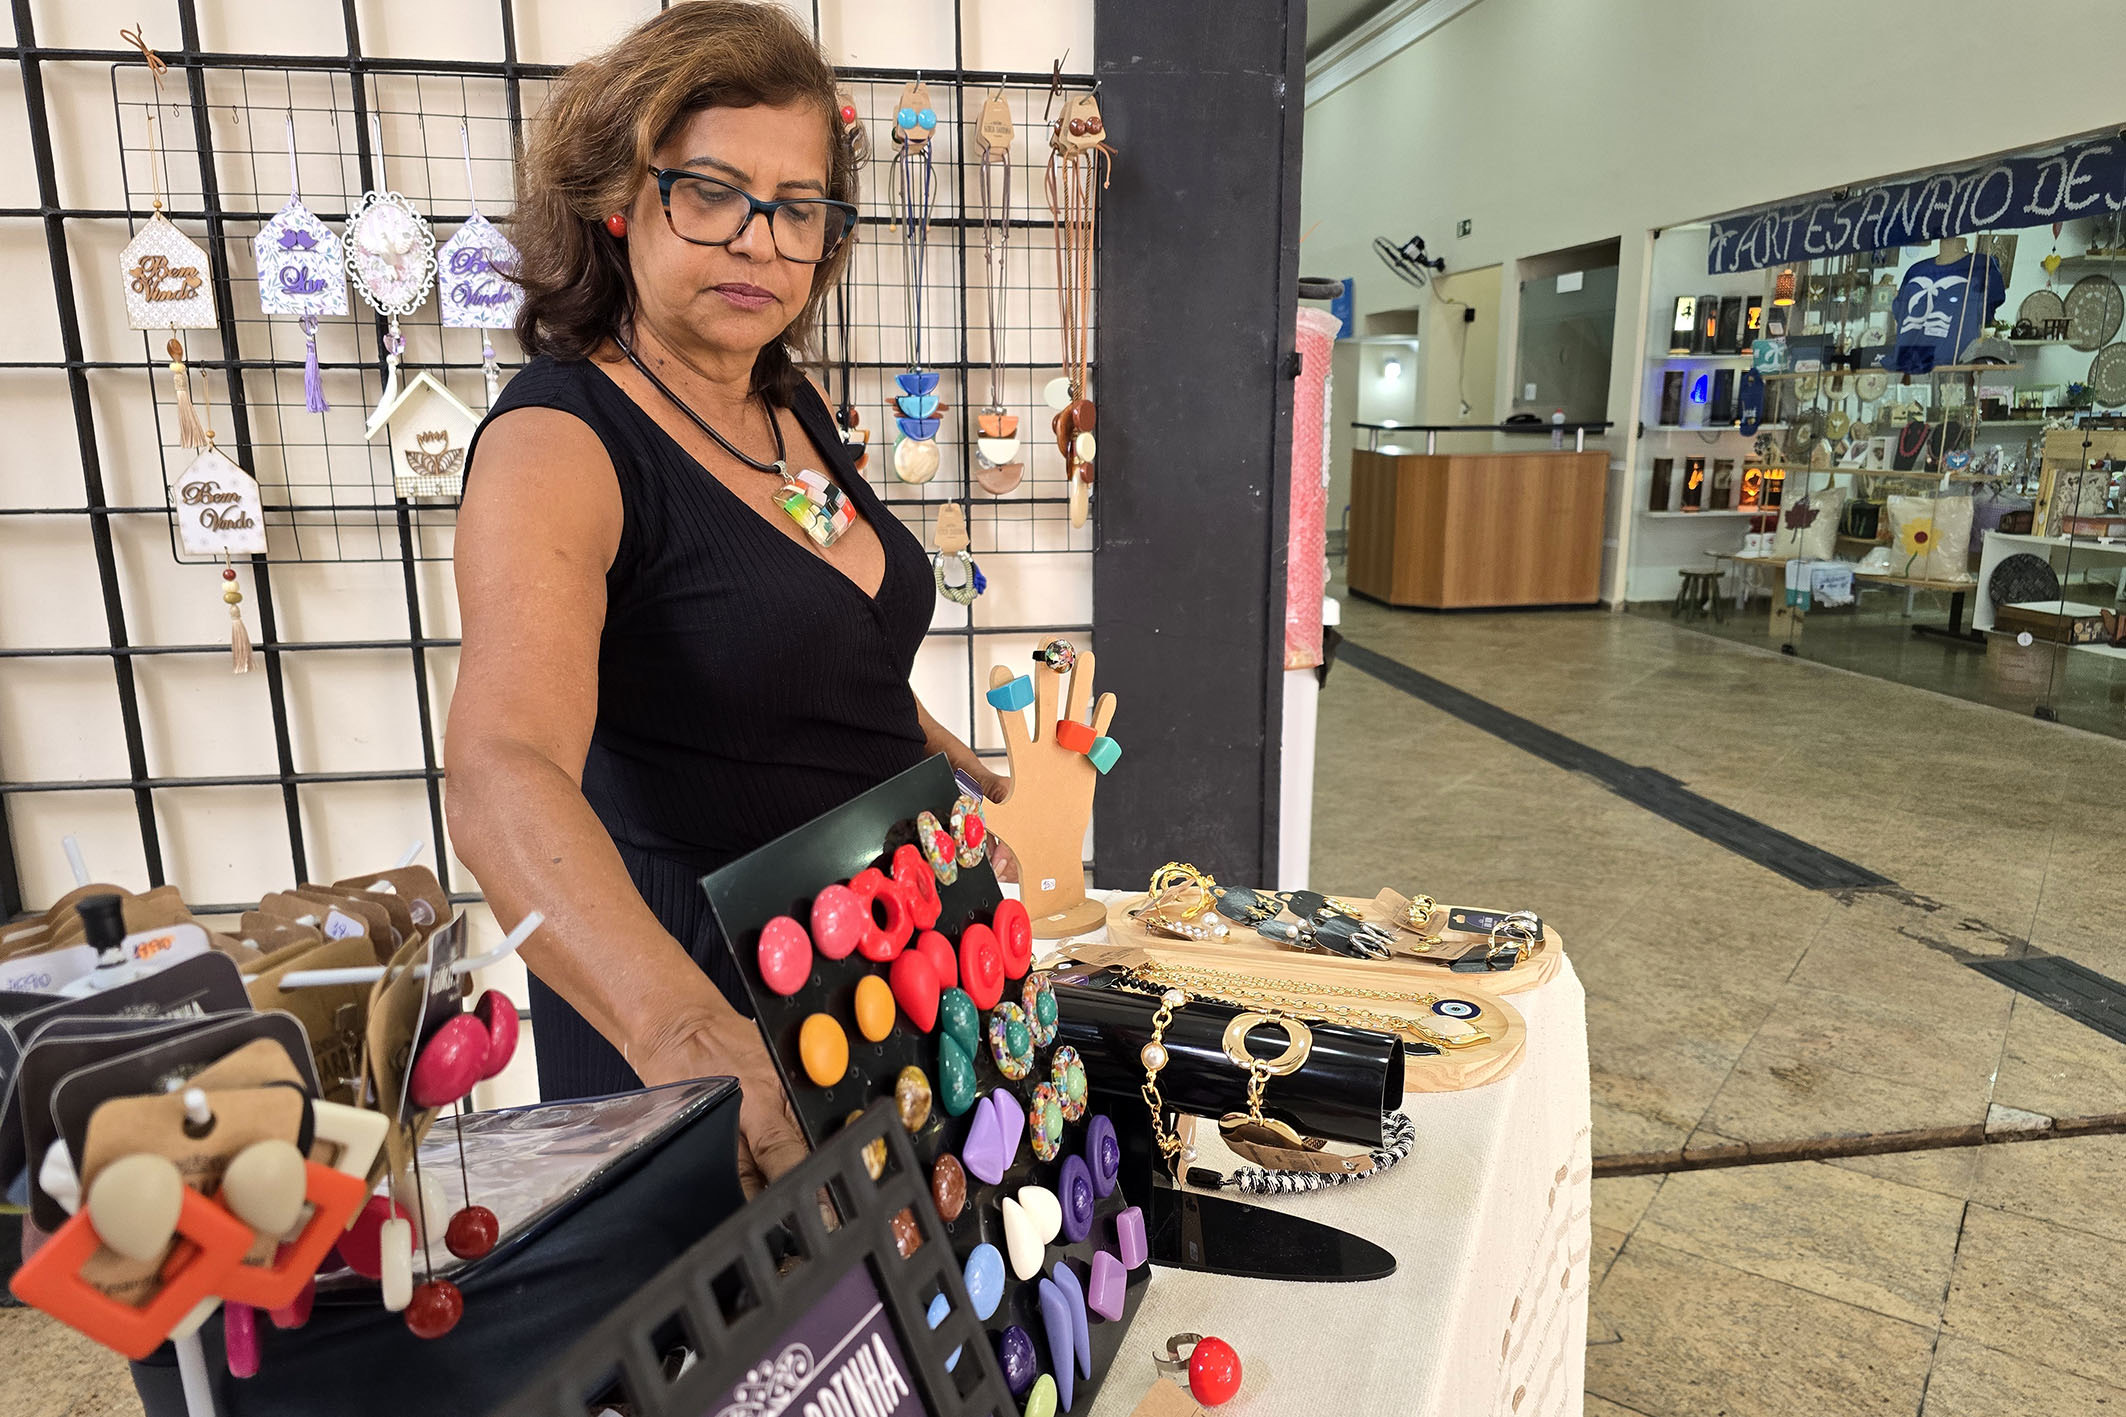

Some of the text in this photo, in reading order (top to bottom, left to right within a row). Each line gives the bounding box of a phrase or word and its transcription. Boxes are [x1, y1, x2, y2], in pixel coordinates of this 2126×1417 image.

[1728, 146, 2112, 273] ARTESANATO DE
[138, 254, 200, 281] Bem
[449, 246, 516, 276] Be
[181, 481, 242, 506] Bem
[199, 505, 256, 533] Vindo
